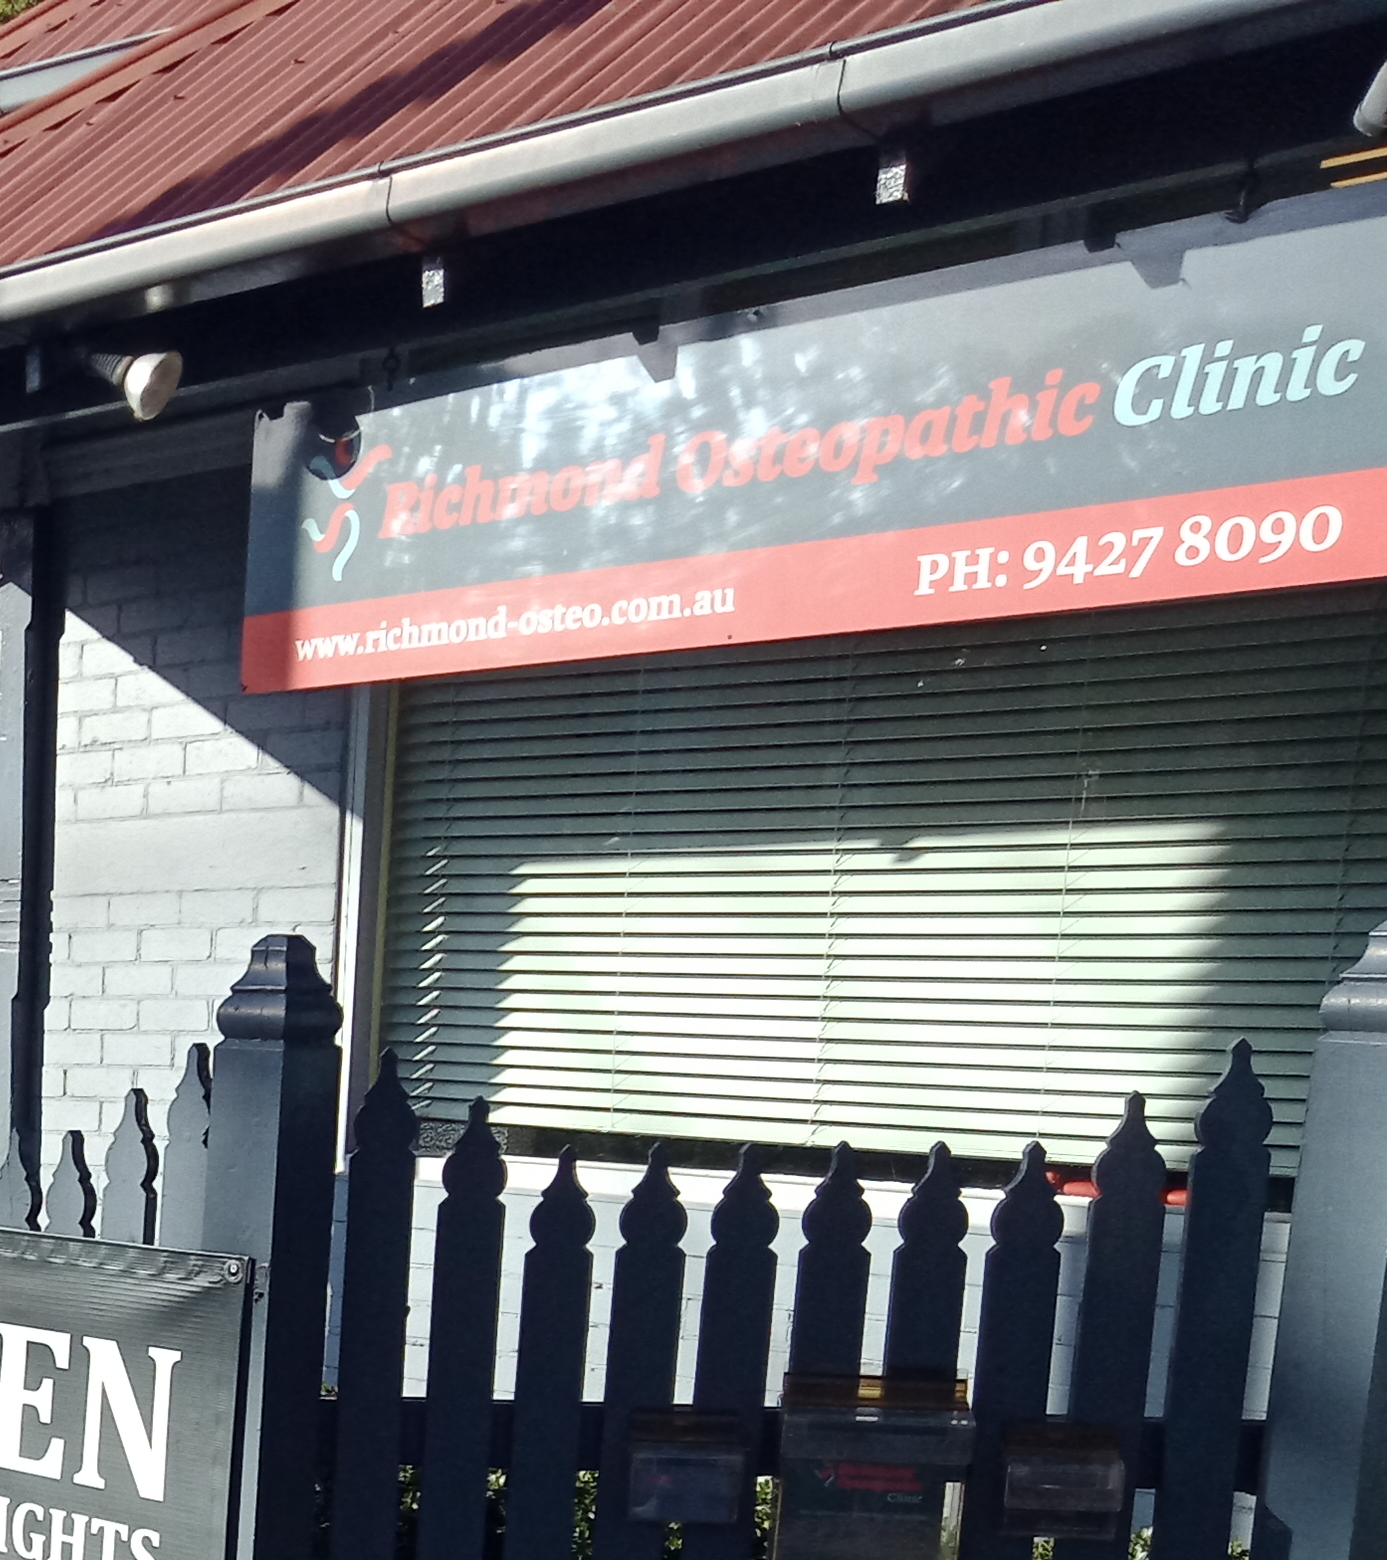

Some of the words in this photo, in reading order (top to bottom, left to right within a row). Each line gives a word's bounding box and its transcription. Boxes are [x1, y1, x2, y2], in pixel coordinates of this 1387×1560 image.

[377, 430, 667, 541] Richmond
[676, 368, 1103, 496] Osteopathic
[1112, 323, 1366, 429] Clinic
[913, 545, 1010, 597] PH:
[1021, 524, 1161, 593] 9427
[1174, 504, 1344, 574] 8090
[294, 582, 736, 663] www.richmond-osteo.com.au
